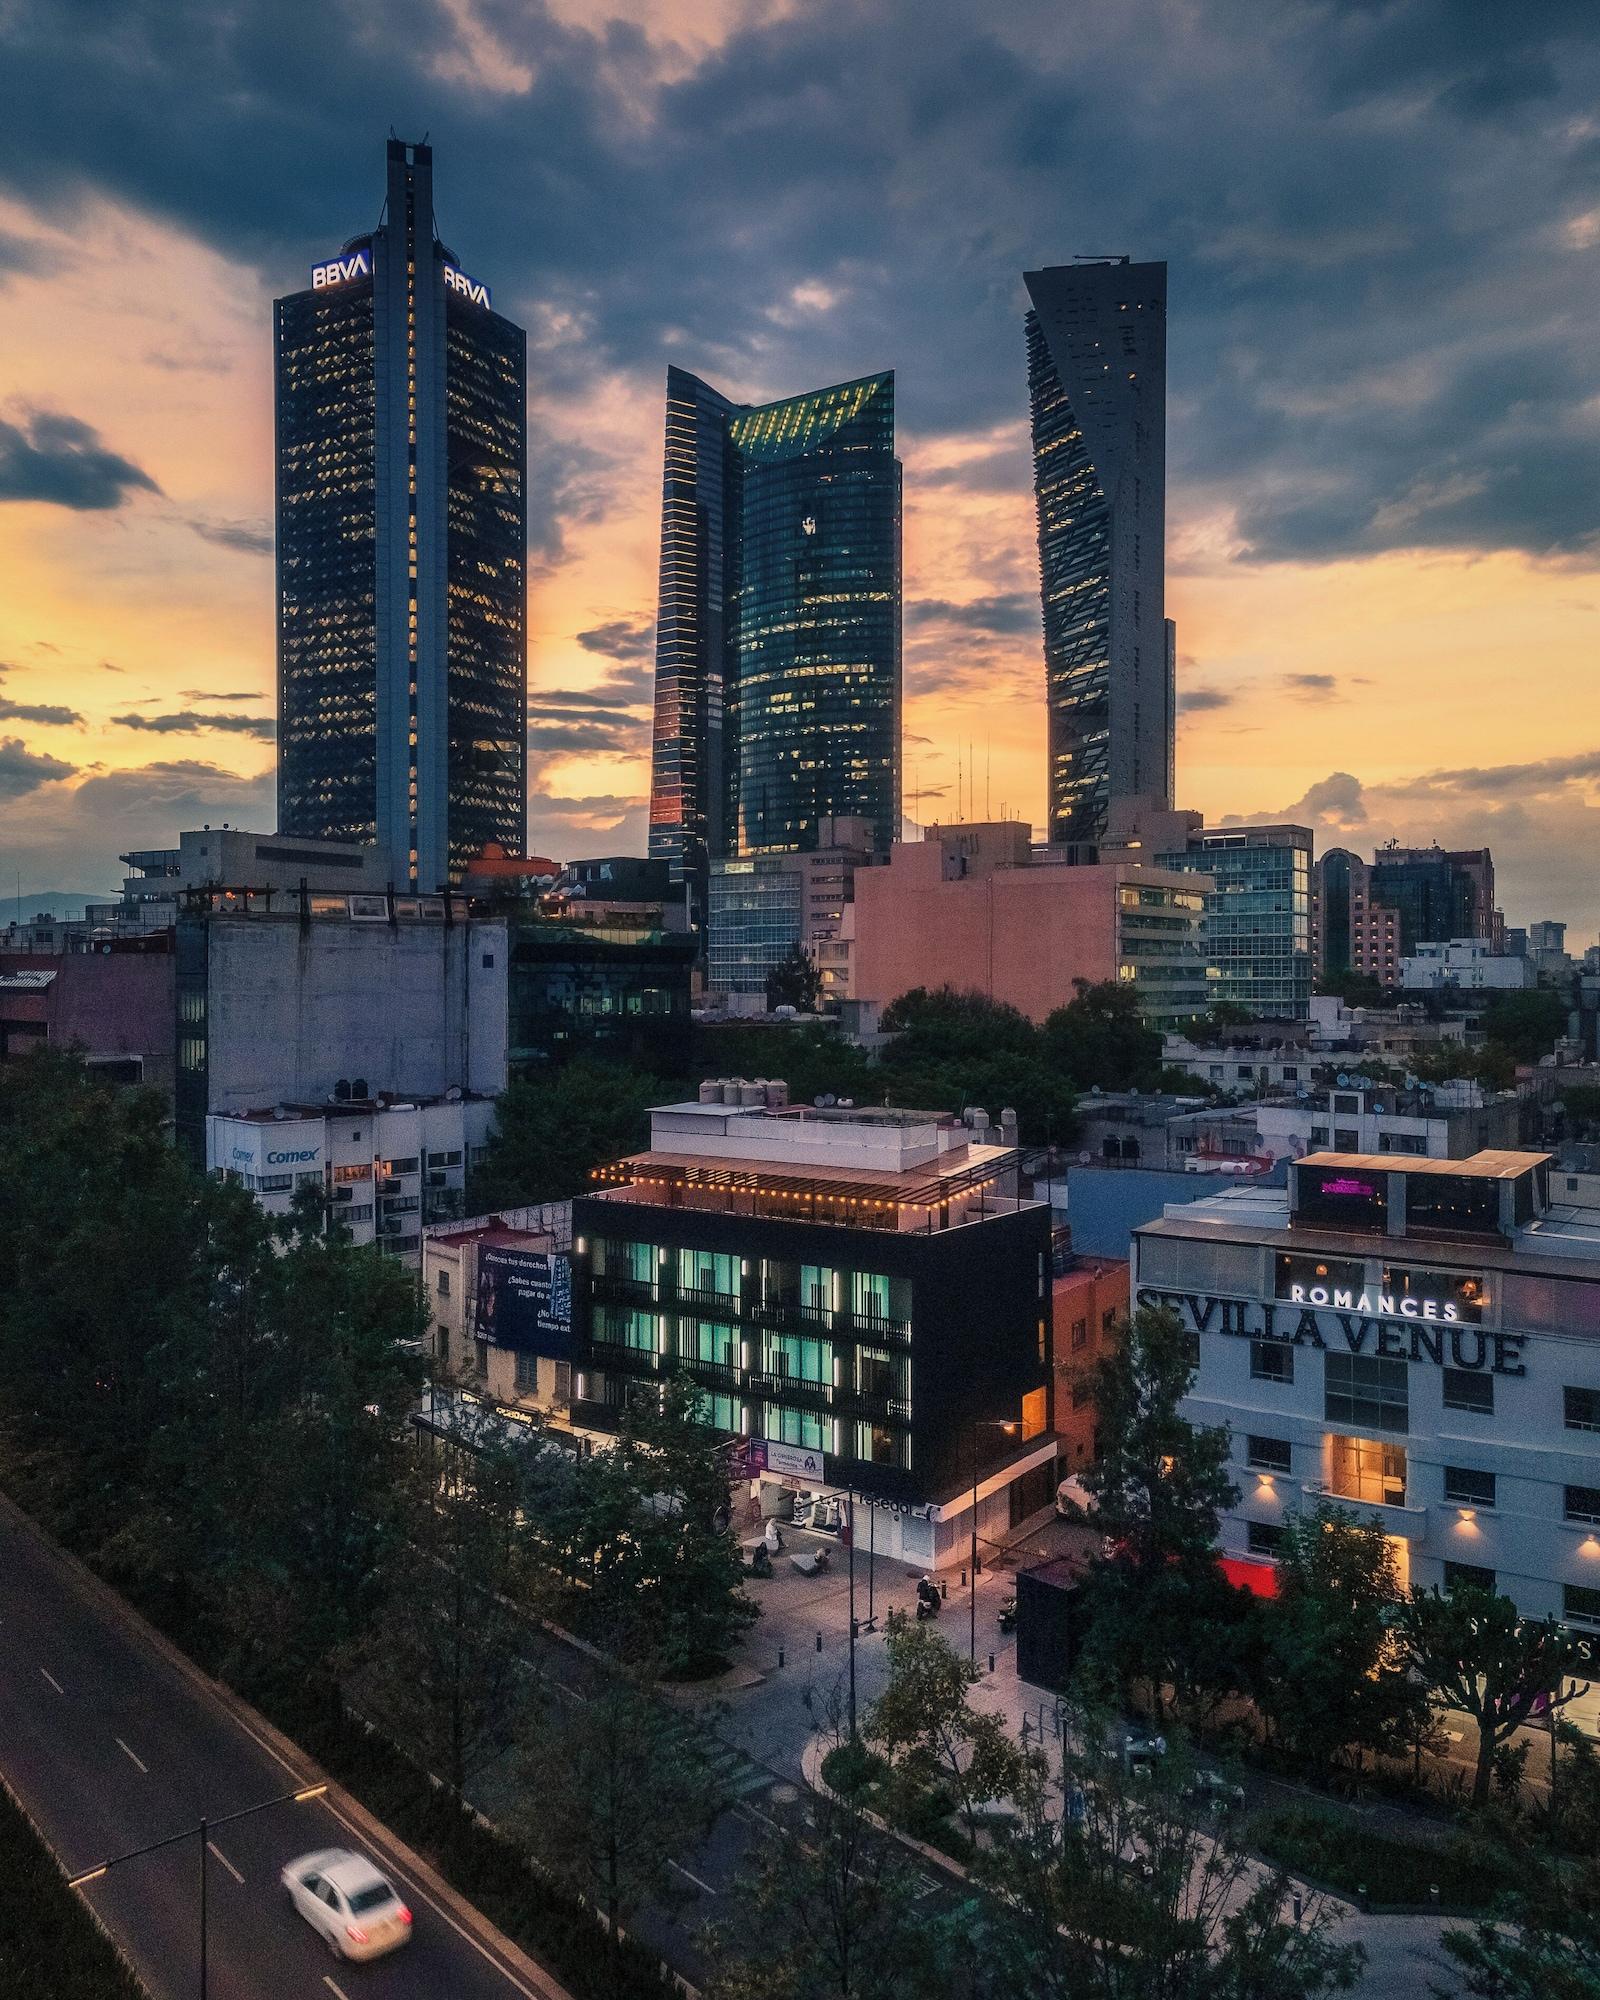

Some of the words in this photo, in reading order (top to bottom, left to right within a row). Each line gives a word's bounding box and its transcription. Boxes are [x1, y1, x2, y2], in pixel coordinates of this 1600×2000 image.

[312, 253, 368, 290] BBVA
[267, 1147, 321, 1164] Comex
[519, 1259, 547, 1271] derechos
[1291, 1284, 1458, 1322] ROMANCES
[537, 1320, 559, 1331] tiempo
